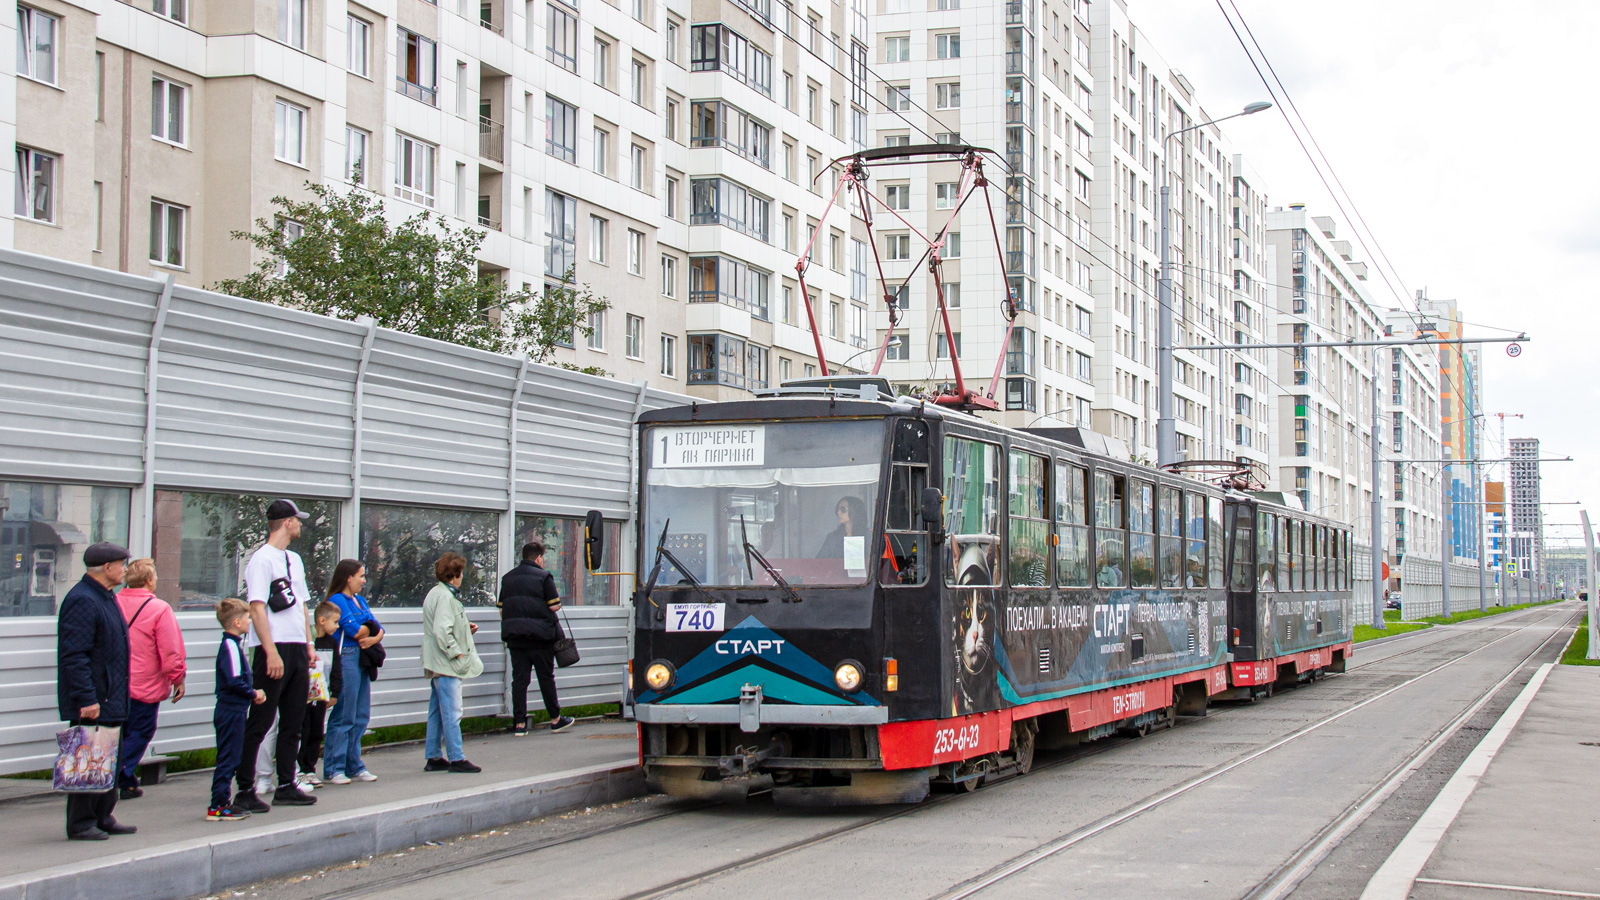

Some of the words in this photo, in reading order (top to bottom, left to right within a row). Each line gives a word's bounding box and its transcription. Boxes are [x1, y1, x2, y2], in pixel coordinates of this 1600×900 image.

[1509, 346, 1519, 354] 25
[661, 436, 668, 464] 1
[675, 430, 756, 446] ВТОРЧЕРМЕТ
[705, 448, 754, 462] ПАРИНА
[675, 610, 715, 630] 740
[1006, 606, 1050, 632] ПОЕХАЛИ...
[1051, 606, 1057, 629] В
[1058, 605, 1088, 631] АКАДЕМ!
[1093, 603, 1130, 638] СТАРТ
[715, 640, 785, 654] СТАРТ
[934, 724, 979, 754] 253-61-23
